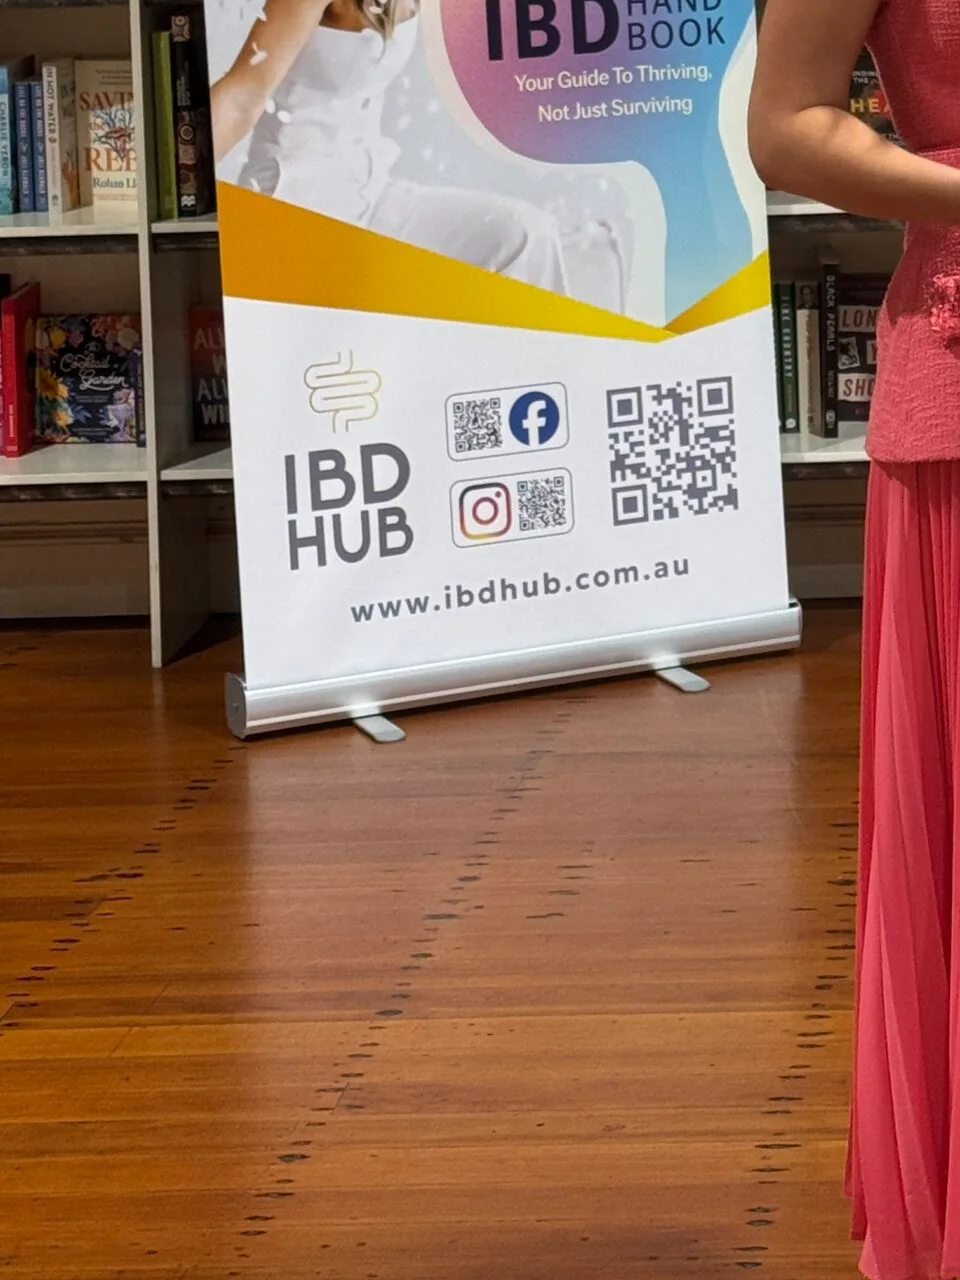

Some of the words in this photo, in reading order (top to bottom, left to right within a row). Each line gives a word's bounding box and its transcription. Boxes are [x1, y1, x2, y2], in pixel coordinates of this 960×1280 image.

[628, 16, 725, 51] BOOK
[47, 80, 55, 101] HOT
[514, 74, 554, 92] Your
[558, 69, 609, 88] Guide
[612, 67, 633, 85] To
[636, 62, 713, 85] Thriving,
[47, 102, 57, 135] WATER
[538, 104, 570, 123] Not
[572, 100, 608, 120] Just
[611, 96, 693, 119] Surviving
[92, 177, 124, 188] Rohan
[826, 274, 836, 308] BLACK
[826, 313, 836, 352] PEARLS
[79, 369, 128, 391] Garden
[284, 442, 411, 515] IBD
[288, 507, 414, 570] HUB
[350, 557, 690, 622] www.ibdhub.com.au
